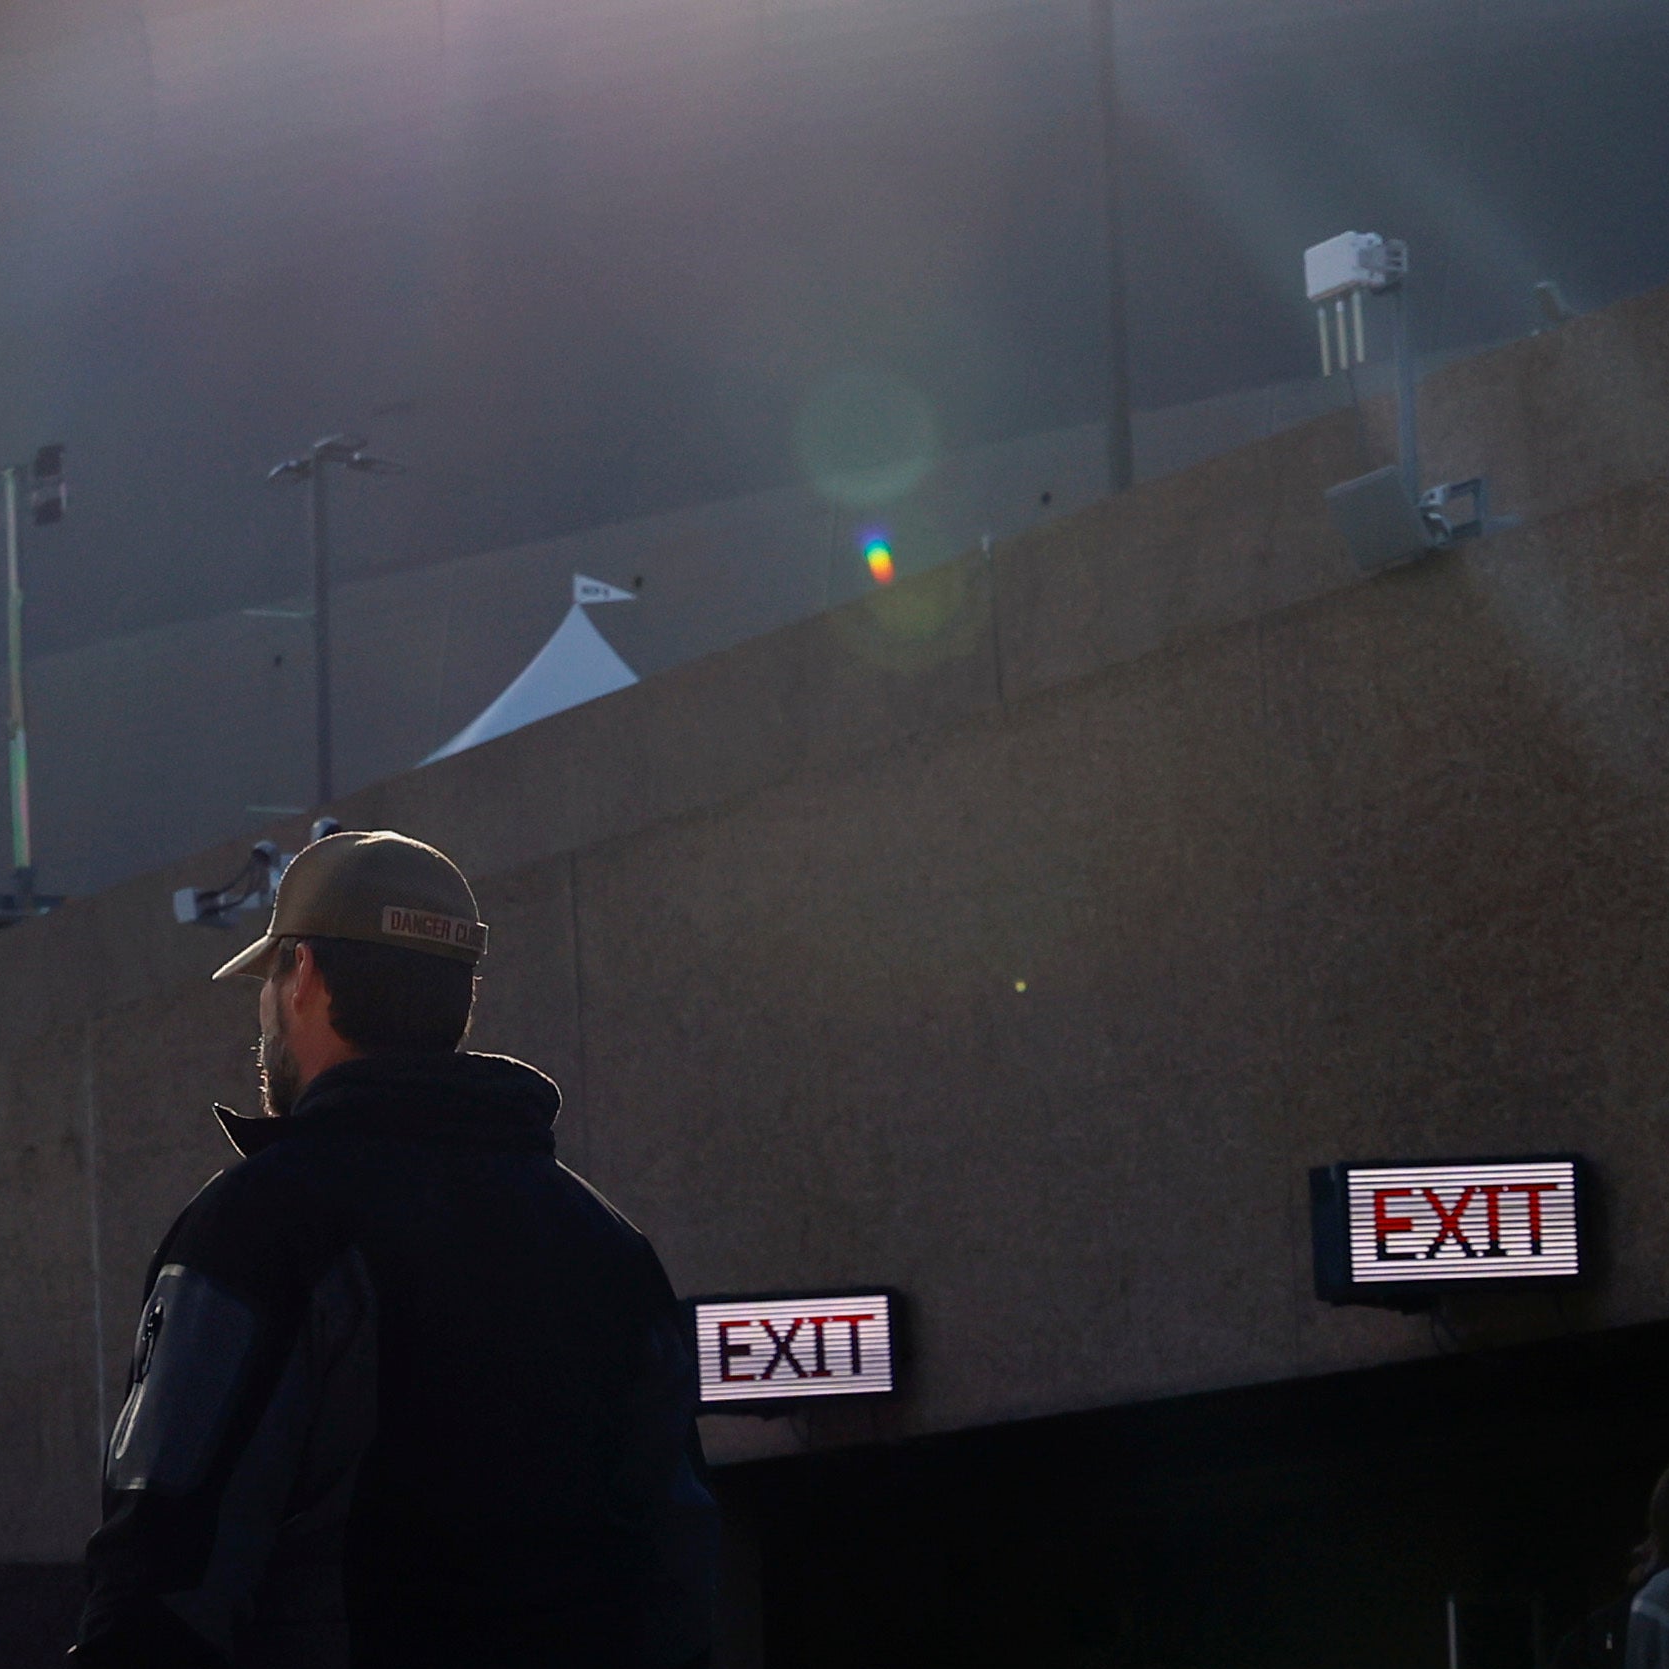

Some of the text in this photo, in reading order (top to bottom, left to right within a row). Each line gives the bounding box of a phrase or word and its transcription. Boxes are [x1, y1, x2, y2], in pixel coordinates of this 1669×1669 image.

[390, 909, 451, 940] DANGER
[1371, 1182, 1559, 1261] EXIT
[717, 1313, 876, 1383] EXIT
